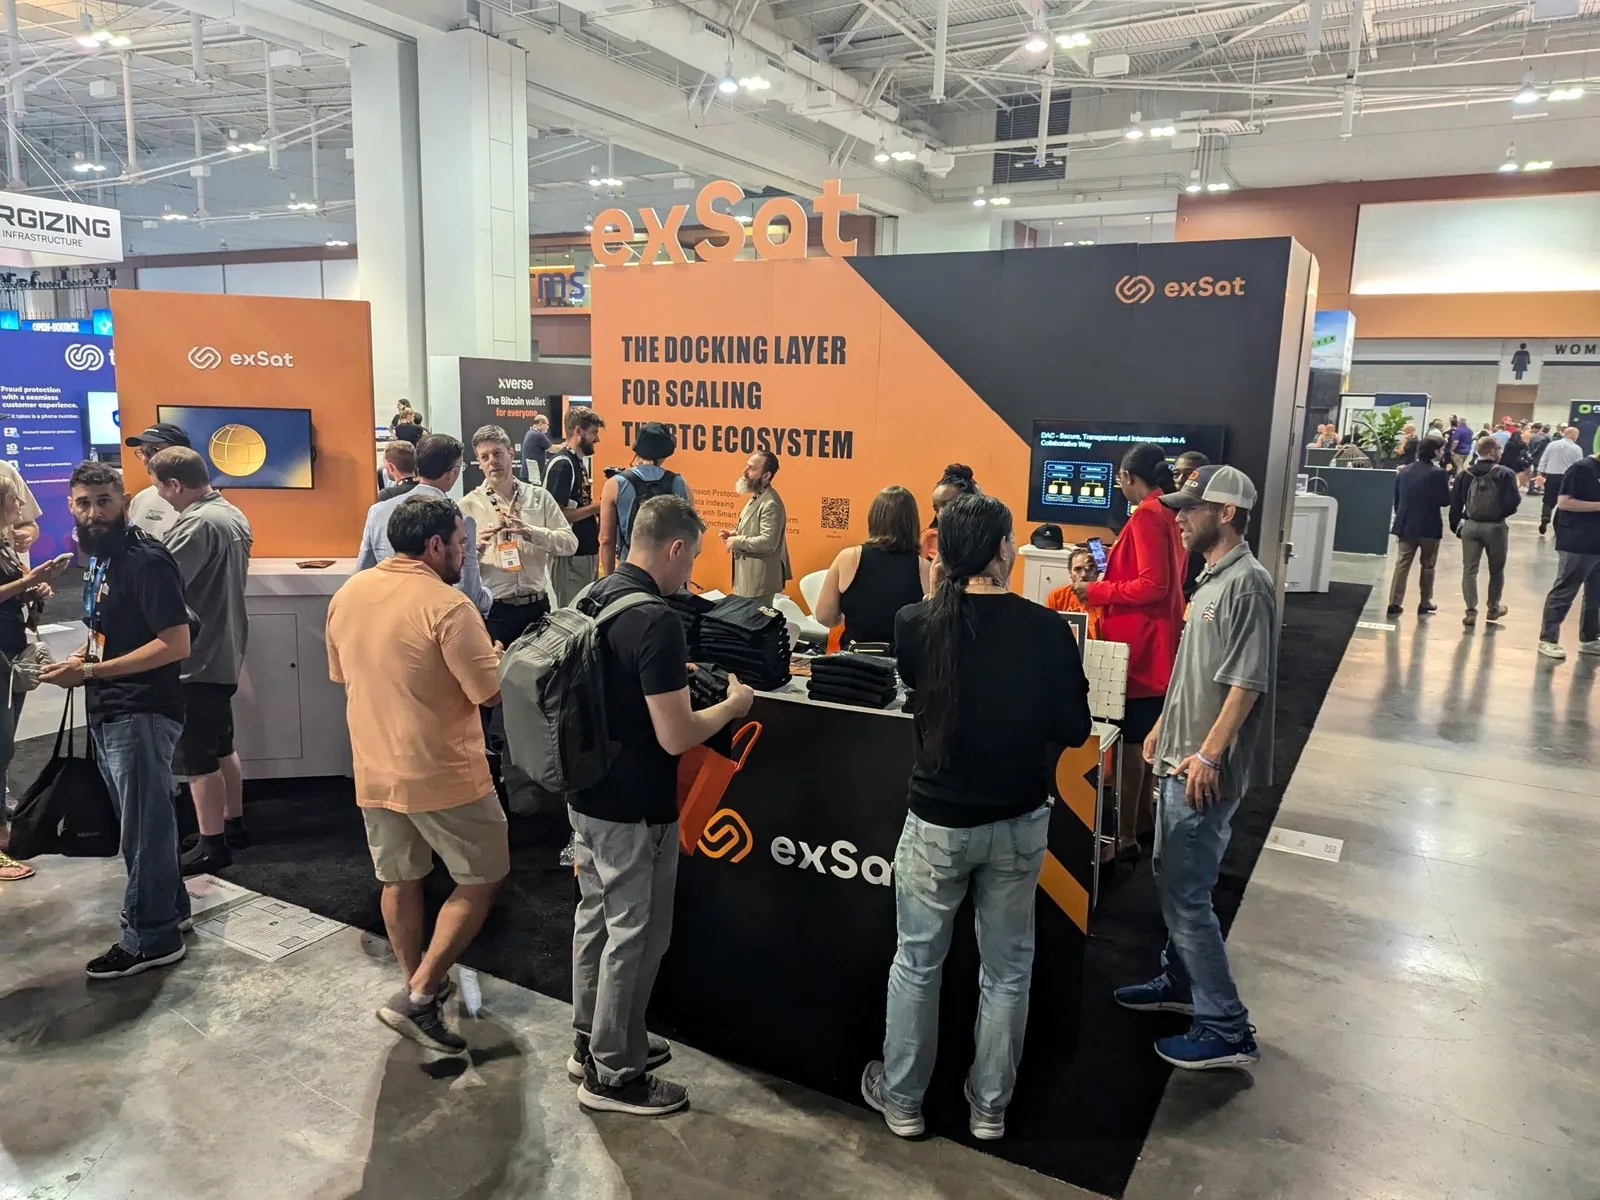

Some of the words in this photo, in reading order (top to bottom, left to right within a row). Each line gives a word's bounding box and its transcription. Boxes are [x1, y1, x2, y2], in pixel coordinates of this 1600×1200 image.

[0, 204, 111, 238] RGIZING
[590, 179, 859, 267] exSat
[2, 230, 84, 247] INFRASTRUCTURE
[530, 272, 585, 299] ms
[1164, 276, 1246, 297] exSat
[230, 350, 294, 368] exSat
[621, 336, 659, 362] THE
[664, 336, 768, 364] DOCKING
[774, 336, 847, 364] LAYER
[24, 386, 62, 394] protection
[622, 379, 660, 405] FOR
[665, 380, 762, 409] SCALING
[486, 396, 500, 405] The
[501, 396, 525, 406] Bitcoin
[526, 397, 546, 406] wallet
[496, 408, 506, 417] for
[507, 410, 538, 419] everyone
[712, 425, 853, 459] ECOSYSTEM
[706, 500, 735, 509] Indexing
[717, 510, 737, 519] Smart
[770, 836, 893, 886] exSa
